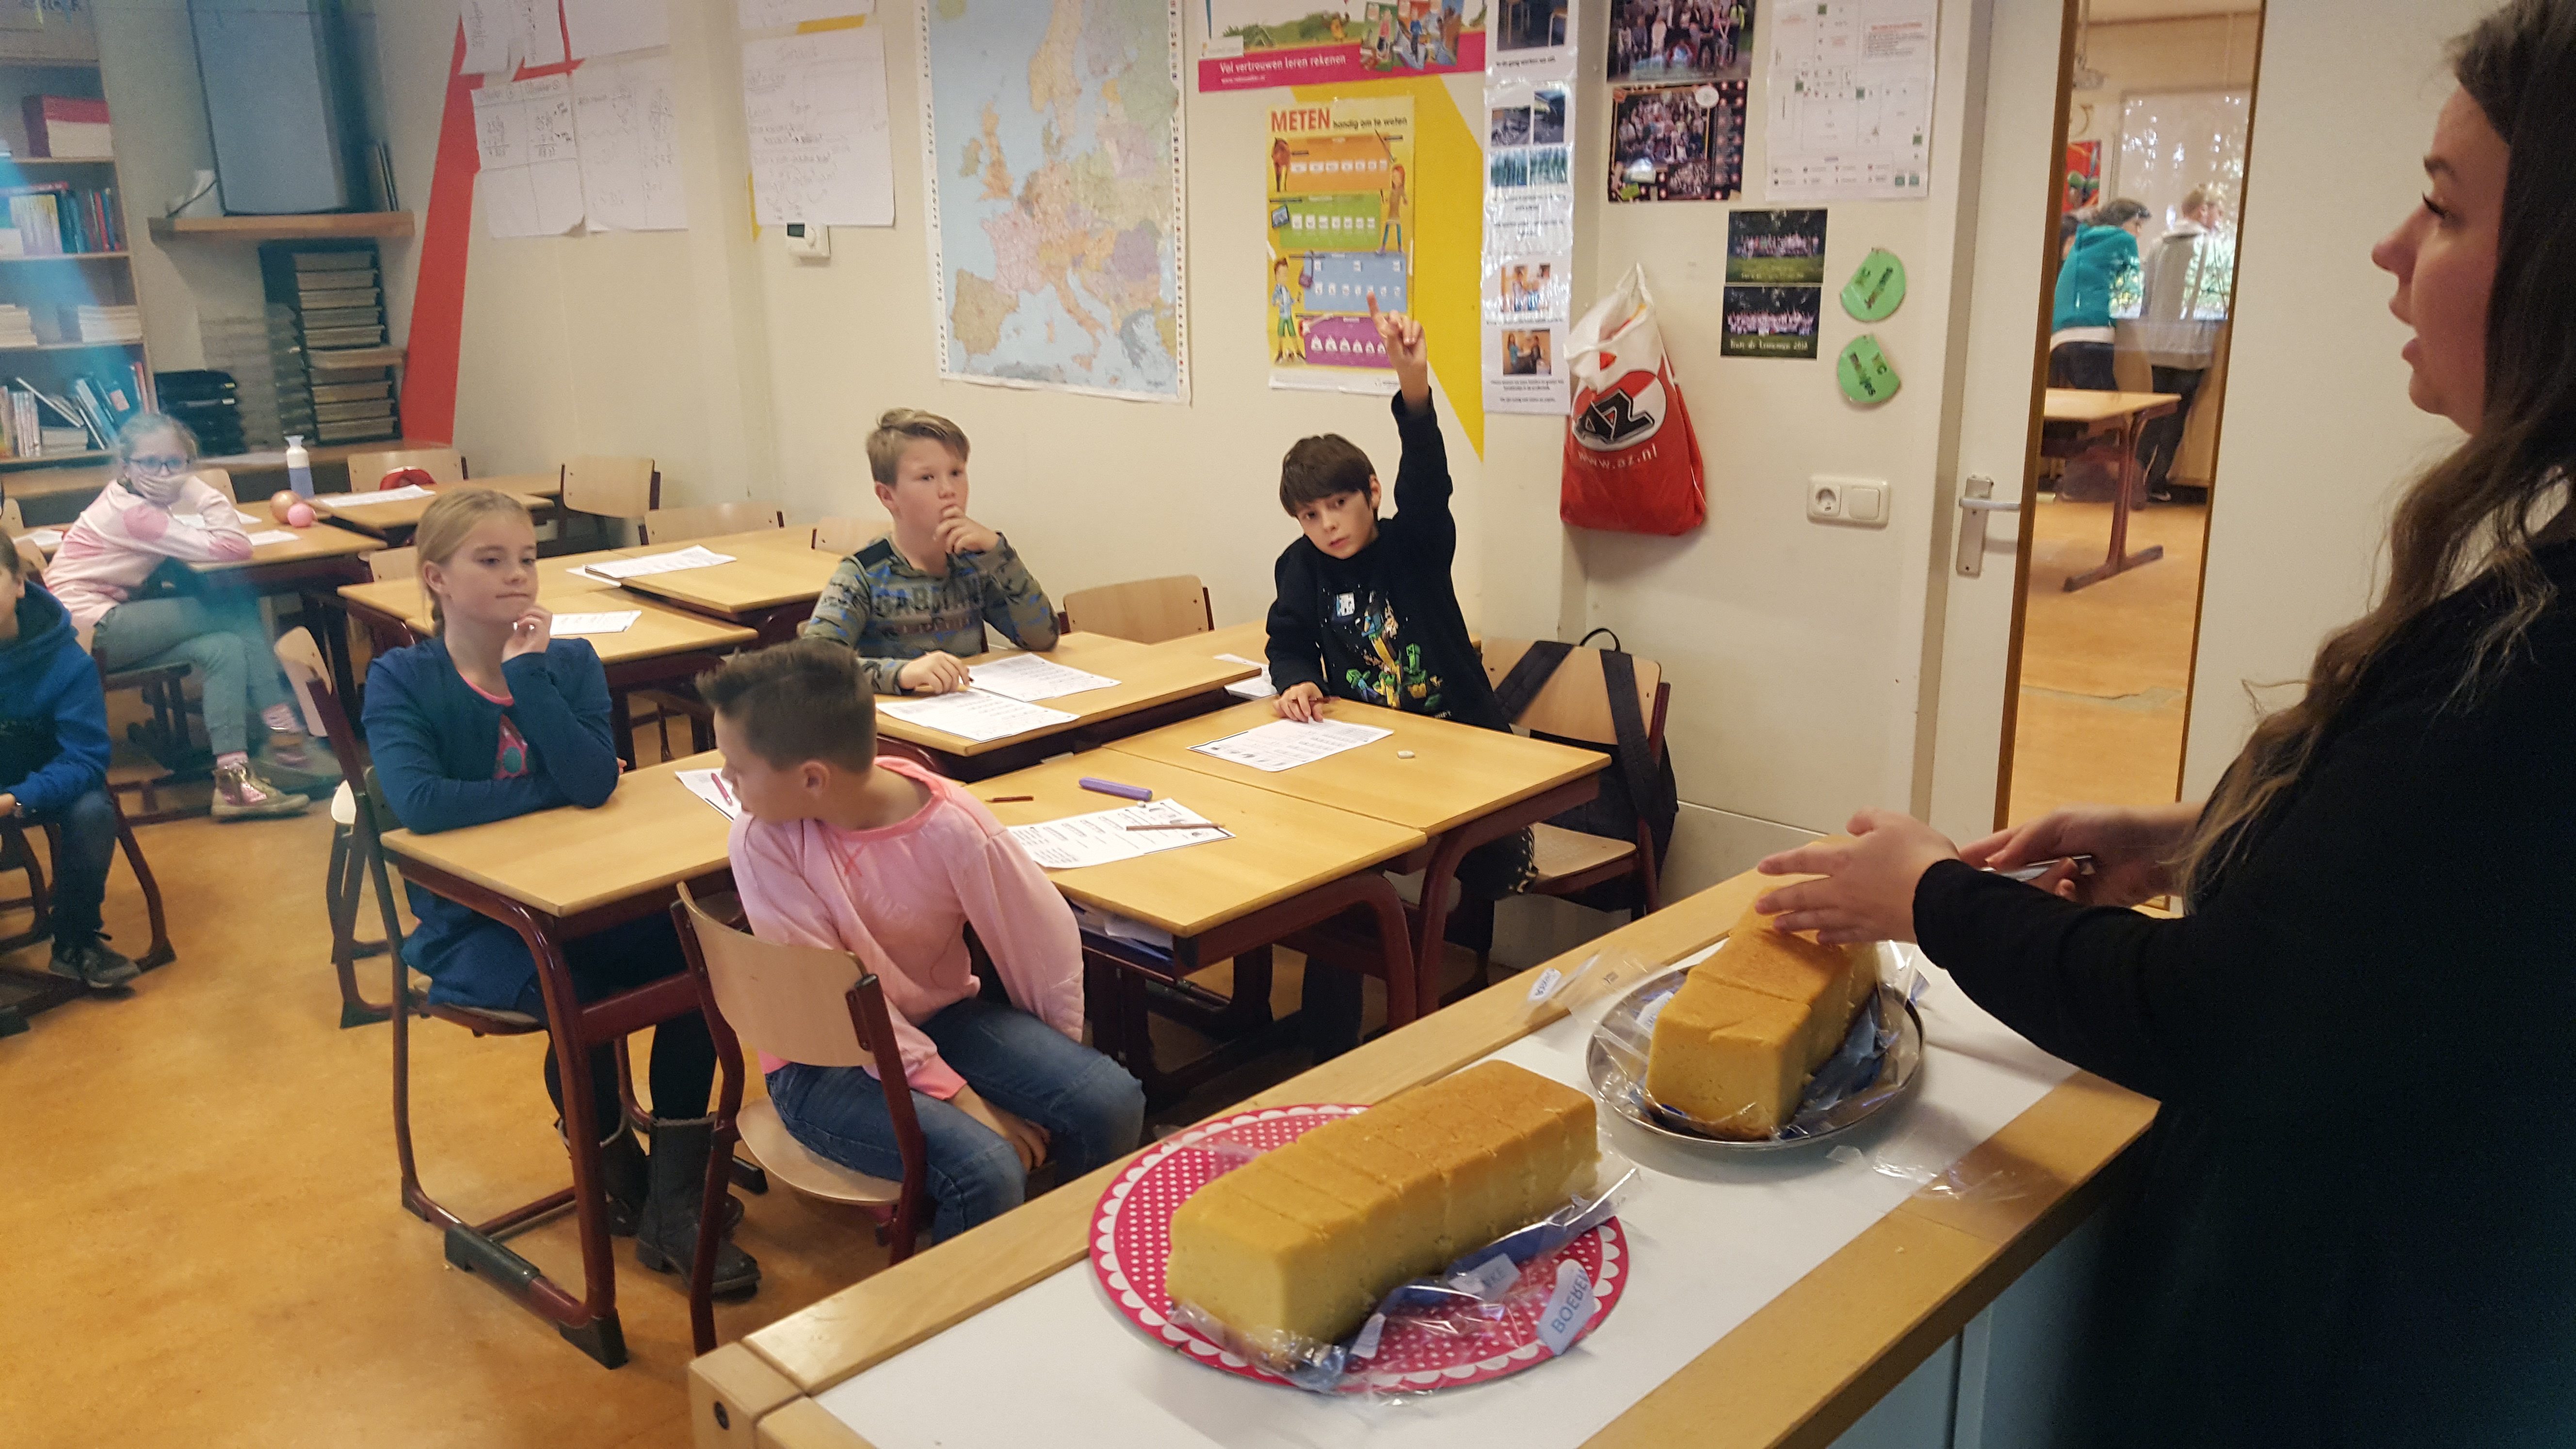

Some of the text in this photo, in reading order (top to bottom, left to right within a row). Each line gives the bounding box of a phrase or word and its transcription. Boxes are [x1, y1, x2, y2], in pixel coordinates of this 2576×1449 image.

[1220, 53, 1346, 74] Vol vertrouwen leren rekenen
[1271, 108, 1331, 132] METEN
[1333, 119, 1358, 130] handig
[1384, 116, 1407, 126] weten
[1576, 387, 1655, 445] AZ
[1578, 443, 1657, 469] www.az.nl
